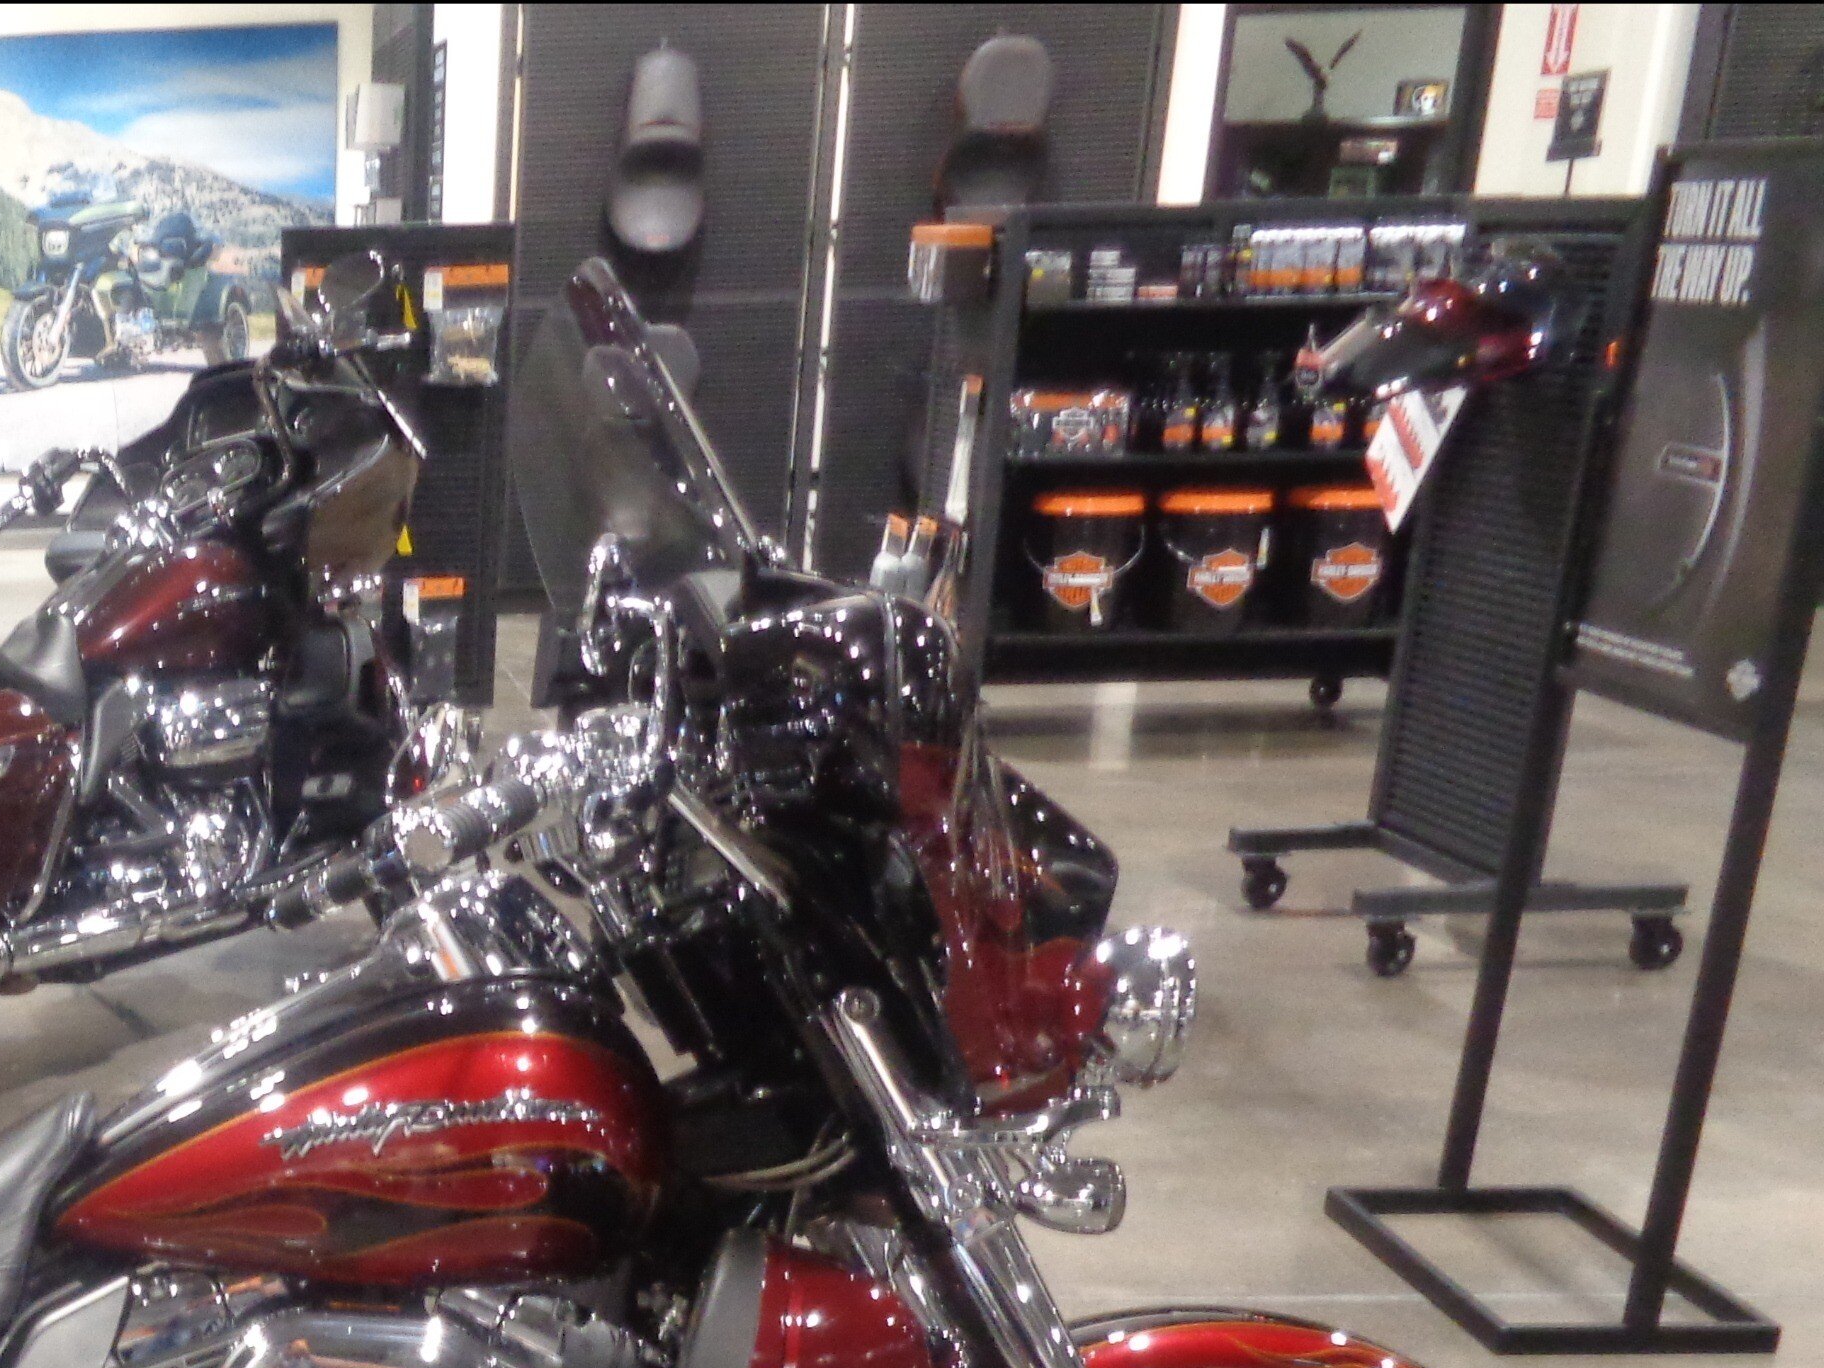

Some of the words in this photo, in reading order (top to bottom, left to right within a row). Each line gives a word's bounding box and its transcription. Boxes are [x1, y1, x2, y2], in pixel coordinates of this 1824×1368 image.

[1706, 179, 1737, 237] IT
[1726, 178, 1766, 237] ALL
[1678, 243, 1727, 302] WAY
